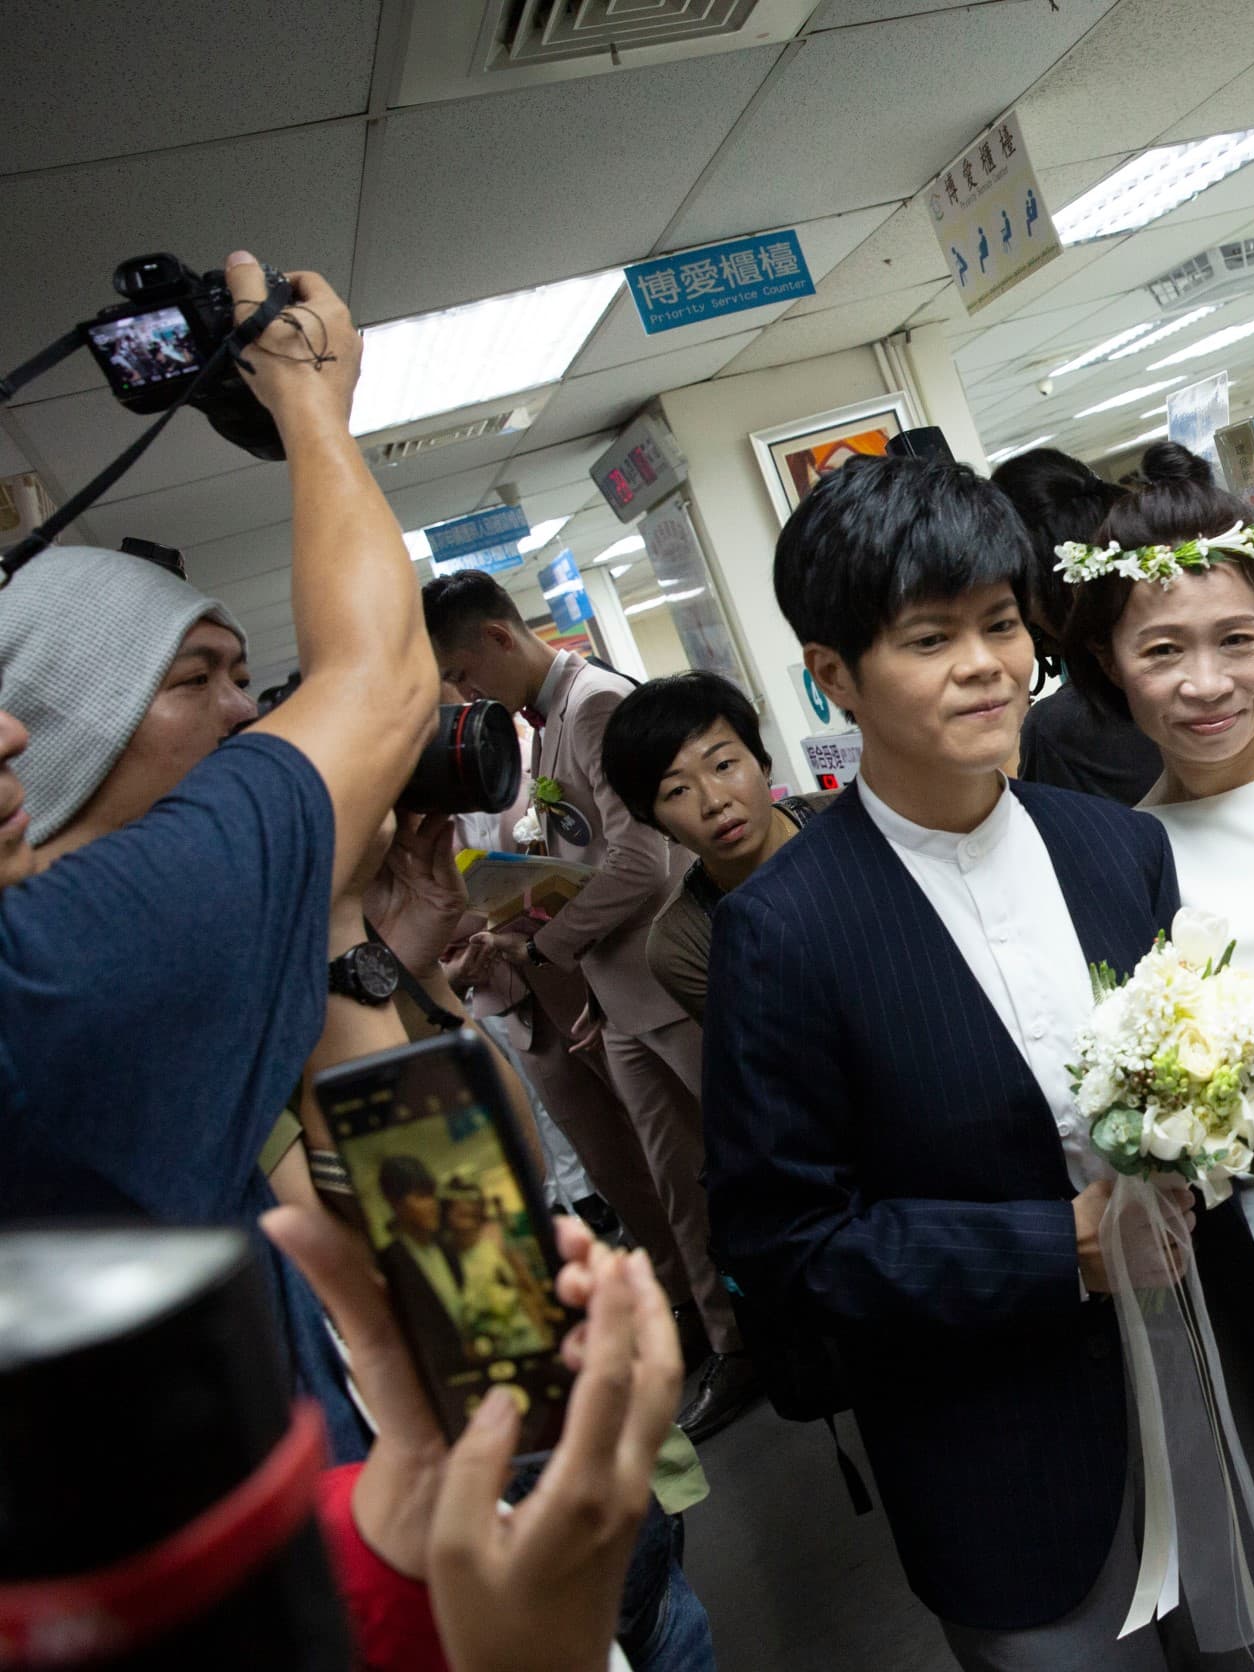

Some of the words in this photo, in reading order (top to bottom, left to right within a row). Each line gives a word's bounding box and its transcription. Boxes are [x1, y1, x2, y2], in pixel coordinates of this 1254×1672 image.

[637, 242, 801, 310] 博愛櫃檯
[650, 303, 705, 323] Priority
[711, 291, 758, 307] Service
[762, 279, 807, 296] Counter
[811, 680, 825, 711] 4
